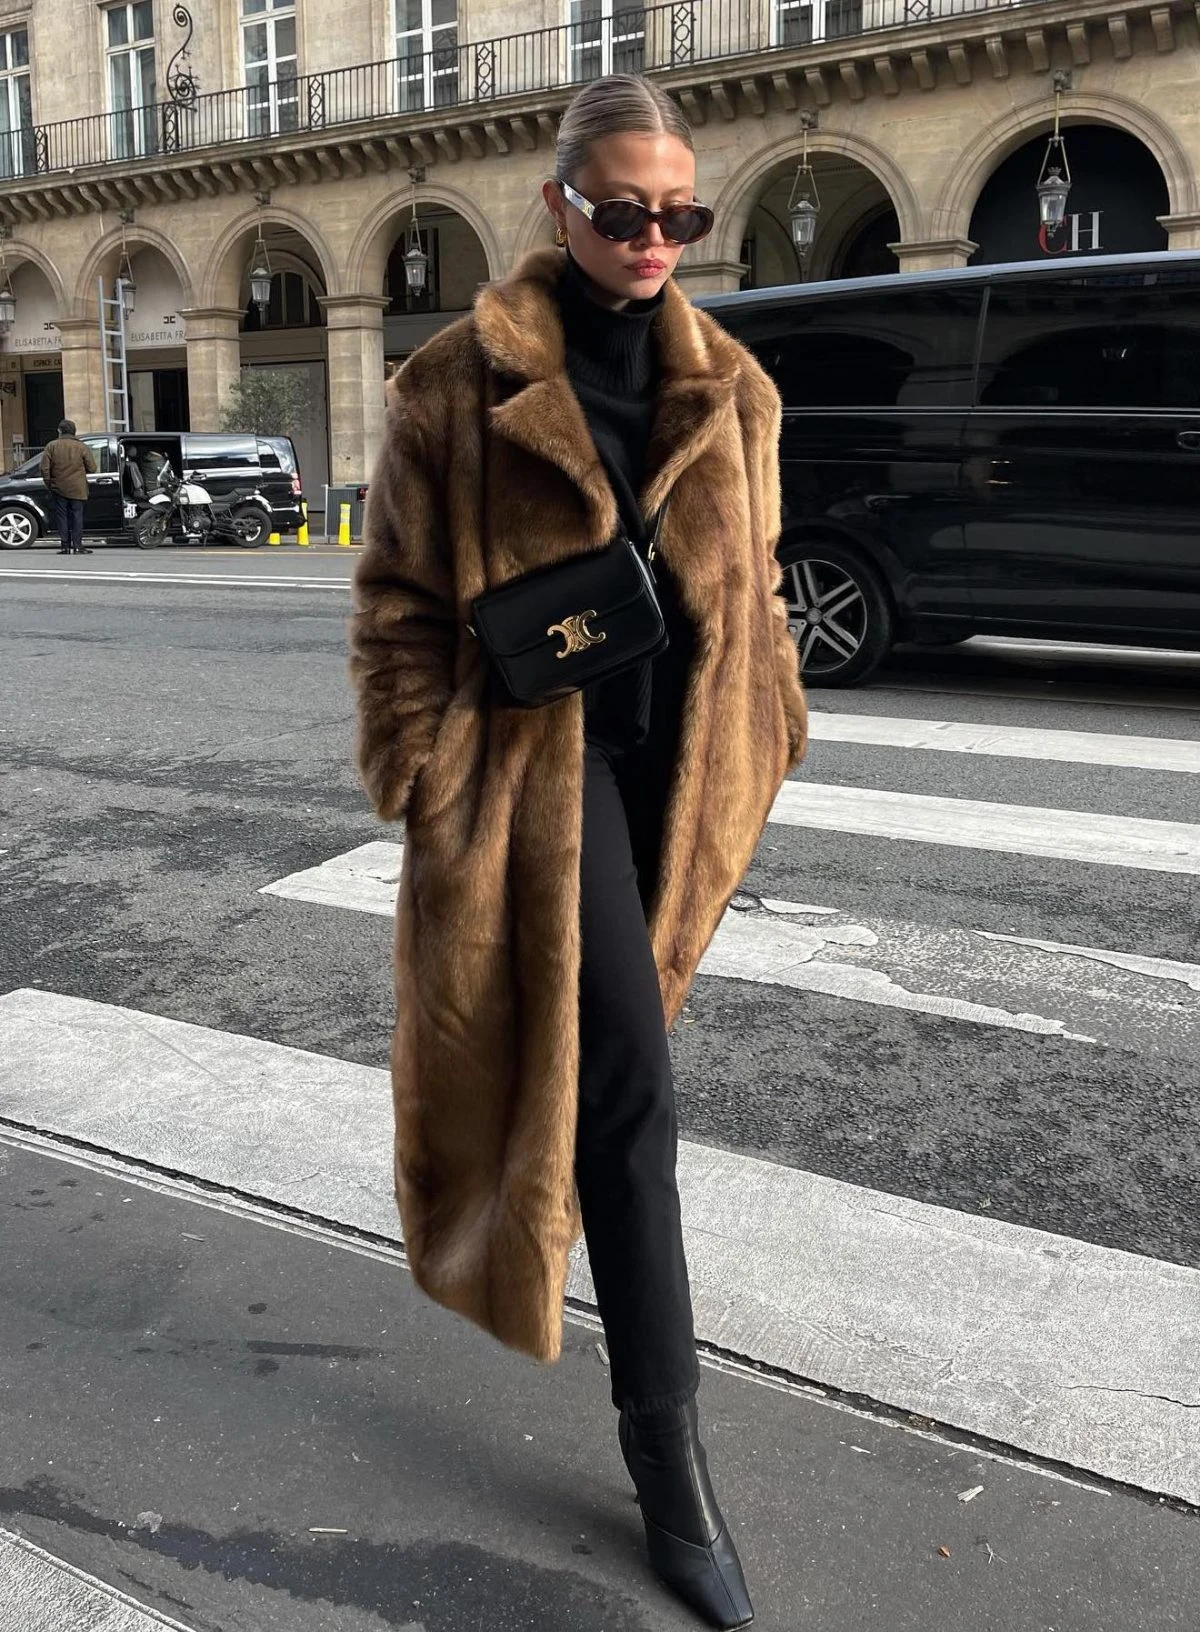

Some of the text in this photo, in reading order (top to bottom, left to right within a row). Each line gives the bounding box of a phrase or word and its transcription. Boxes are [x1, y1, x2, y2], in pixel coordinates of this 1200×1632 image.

[1038, 210, 1105, 254] CH
[15, 337, 53, 347] ELISABETTA
[131, 331, 173, 342] ELISABETTA
